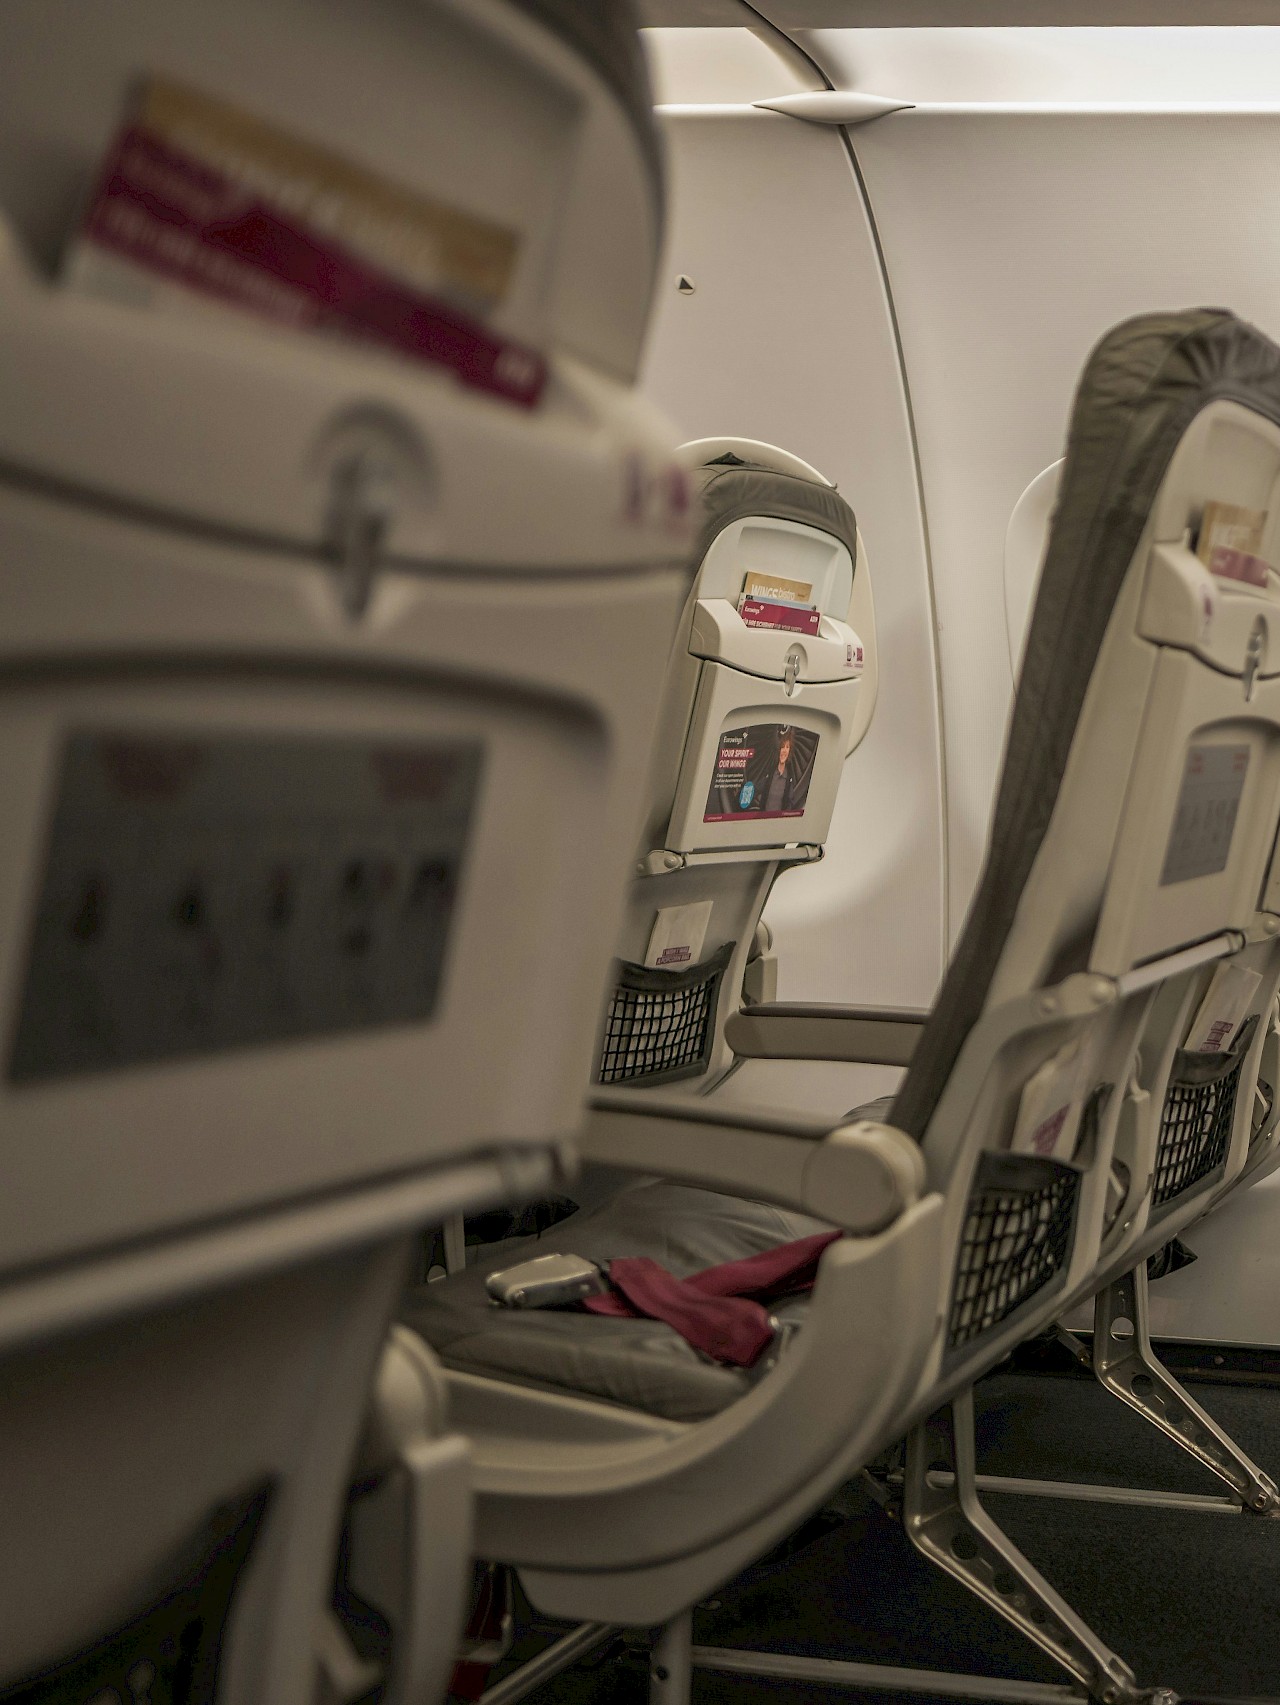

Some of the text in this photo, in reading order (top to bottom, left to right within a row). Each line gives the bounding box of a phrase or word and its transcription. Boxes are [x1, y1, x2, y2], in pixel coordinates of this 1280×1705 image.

[721, 749, 734, 757] YOUR
[735, 749, 750, 757] SPIRIT
[718, 760, 746, 768] OUR WINGS
